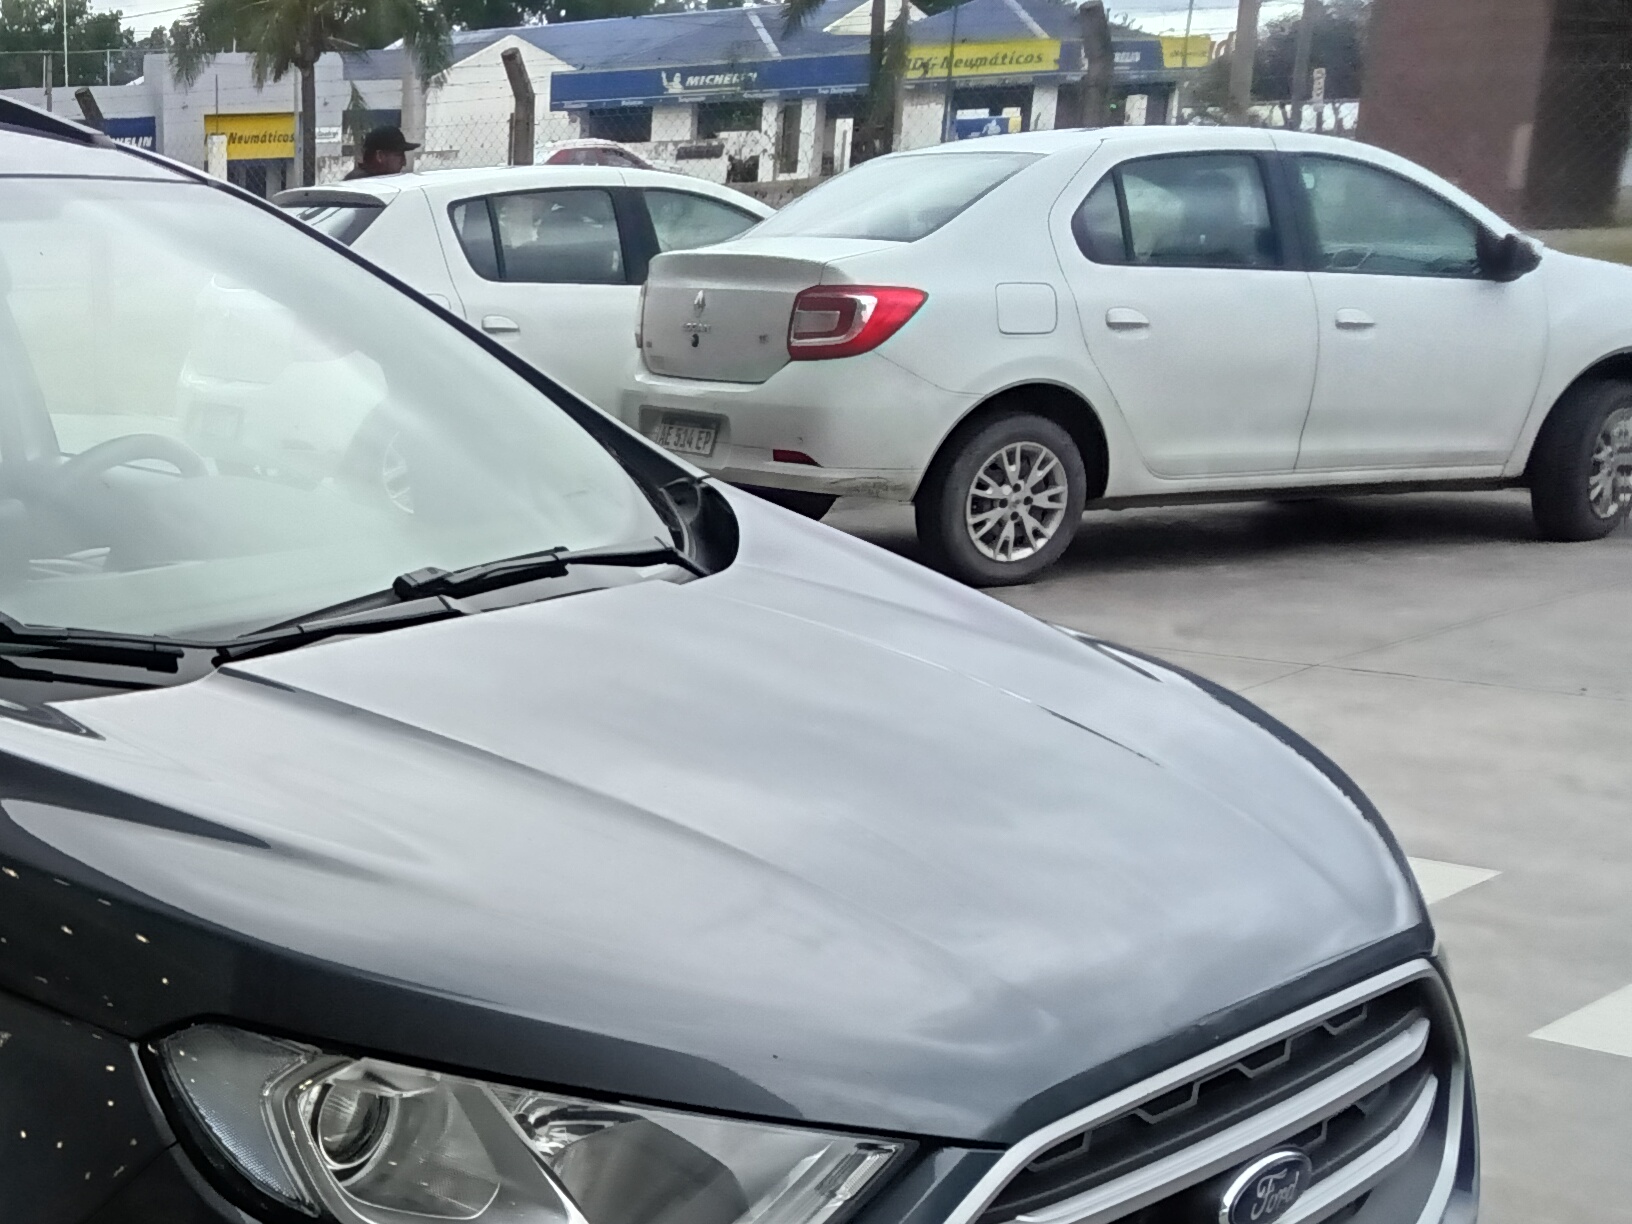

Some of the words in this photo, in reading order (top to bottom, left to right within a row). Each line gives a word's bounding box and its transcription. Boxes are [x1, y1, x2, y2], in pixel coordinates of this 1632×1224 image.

[940, 51, 1043, 71] Neumáticos
[228, 130, 295, 146] Neumáticos
[695, 430, 712, 451] EP
[1250, 1167, 1300, 1221] Ford
